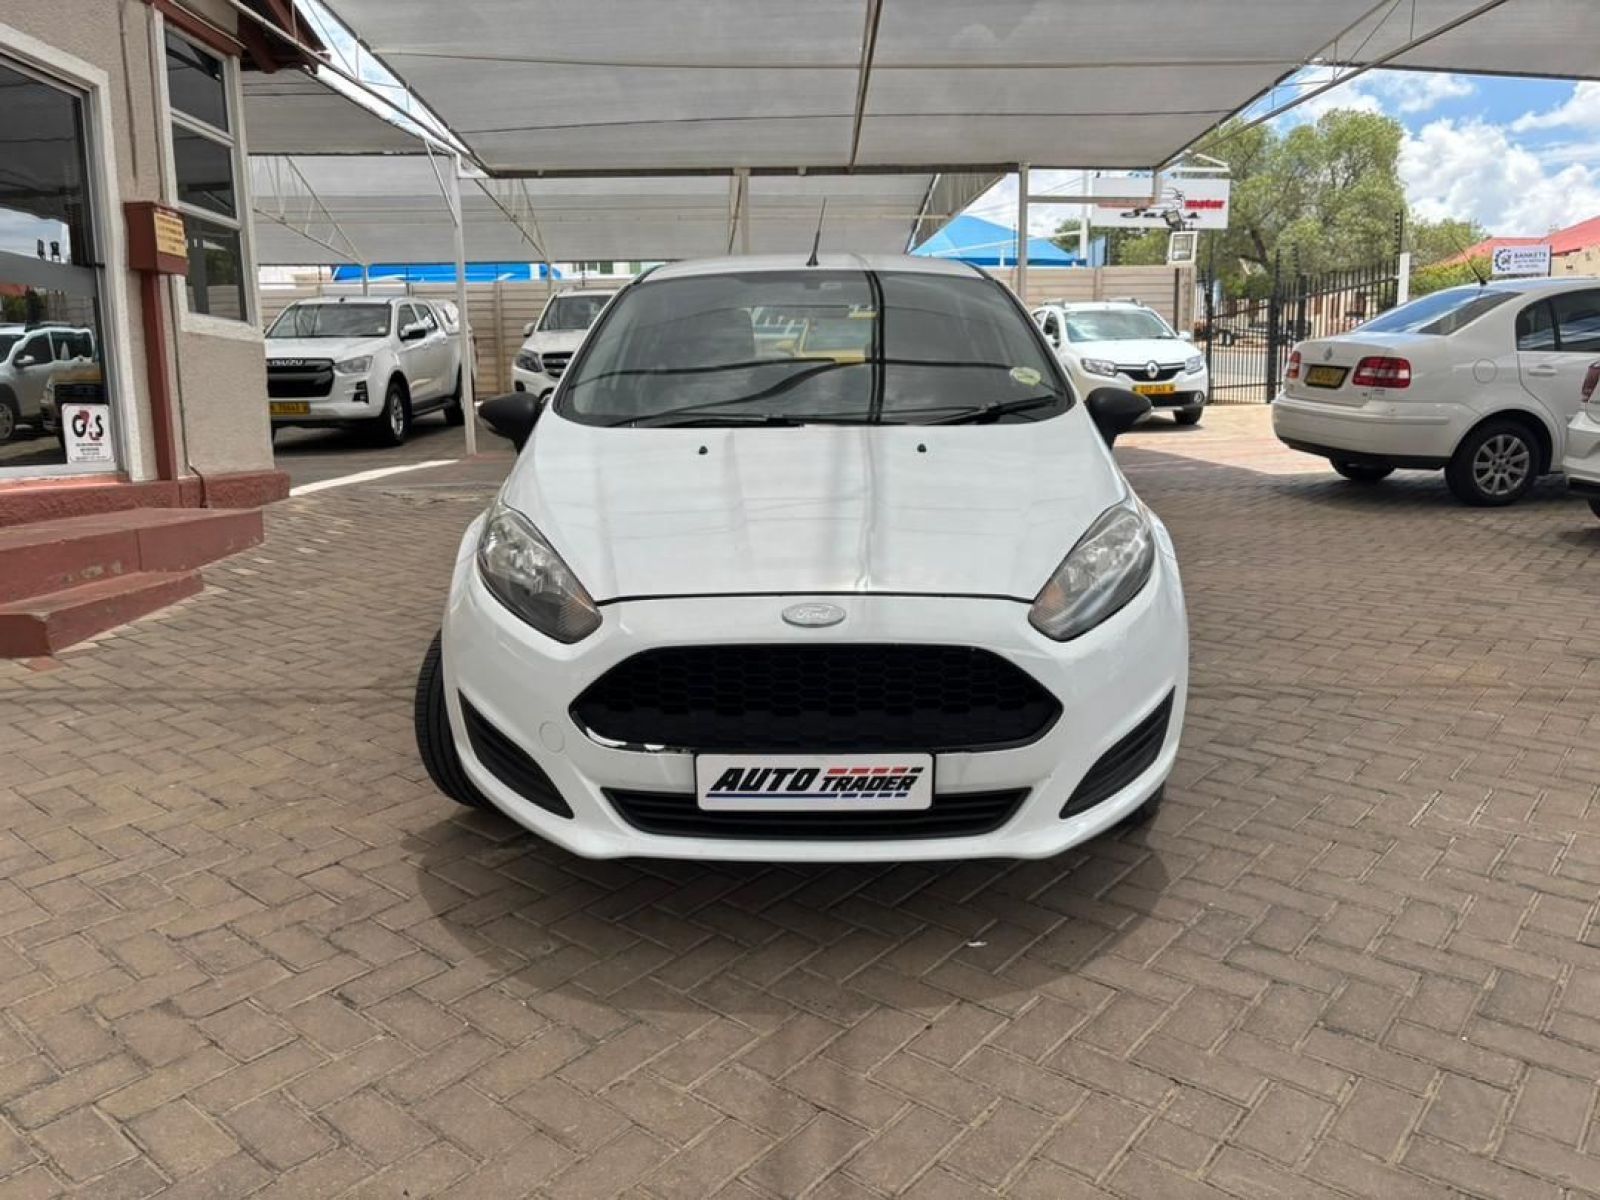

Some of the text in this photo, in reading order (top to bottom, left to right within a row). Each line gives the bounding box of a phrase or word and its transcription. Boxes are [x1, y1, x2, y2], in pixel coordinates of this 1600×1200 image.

[271, 358, 304, 366] ISUZU
[710, 767, 919, 792] AUTO TRADER
